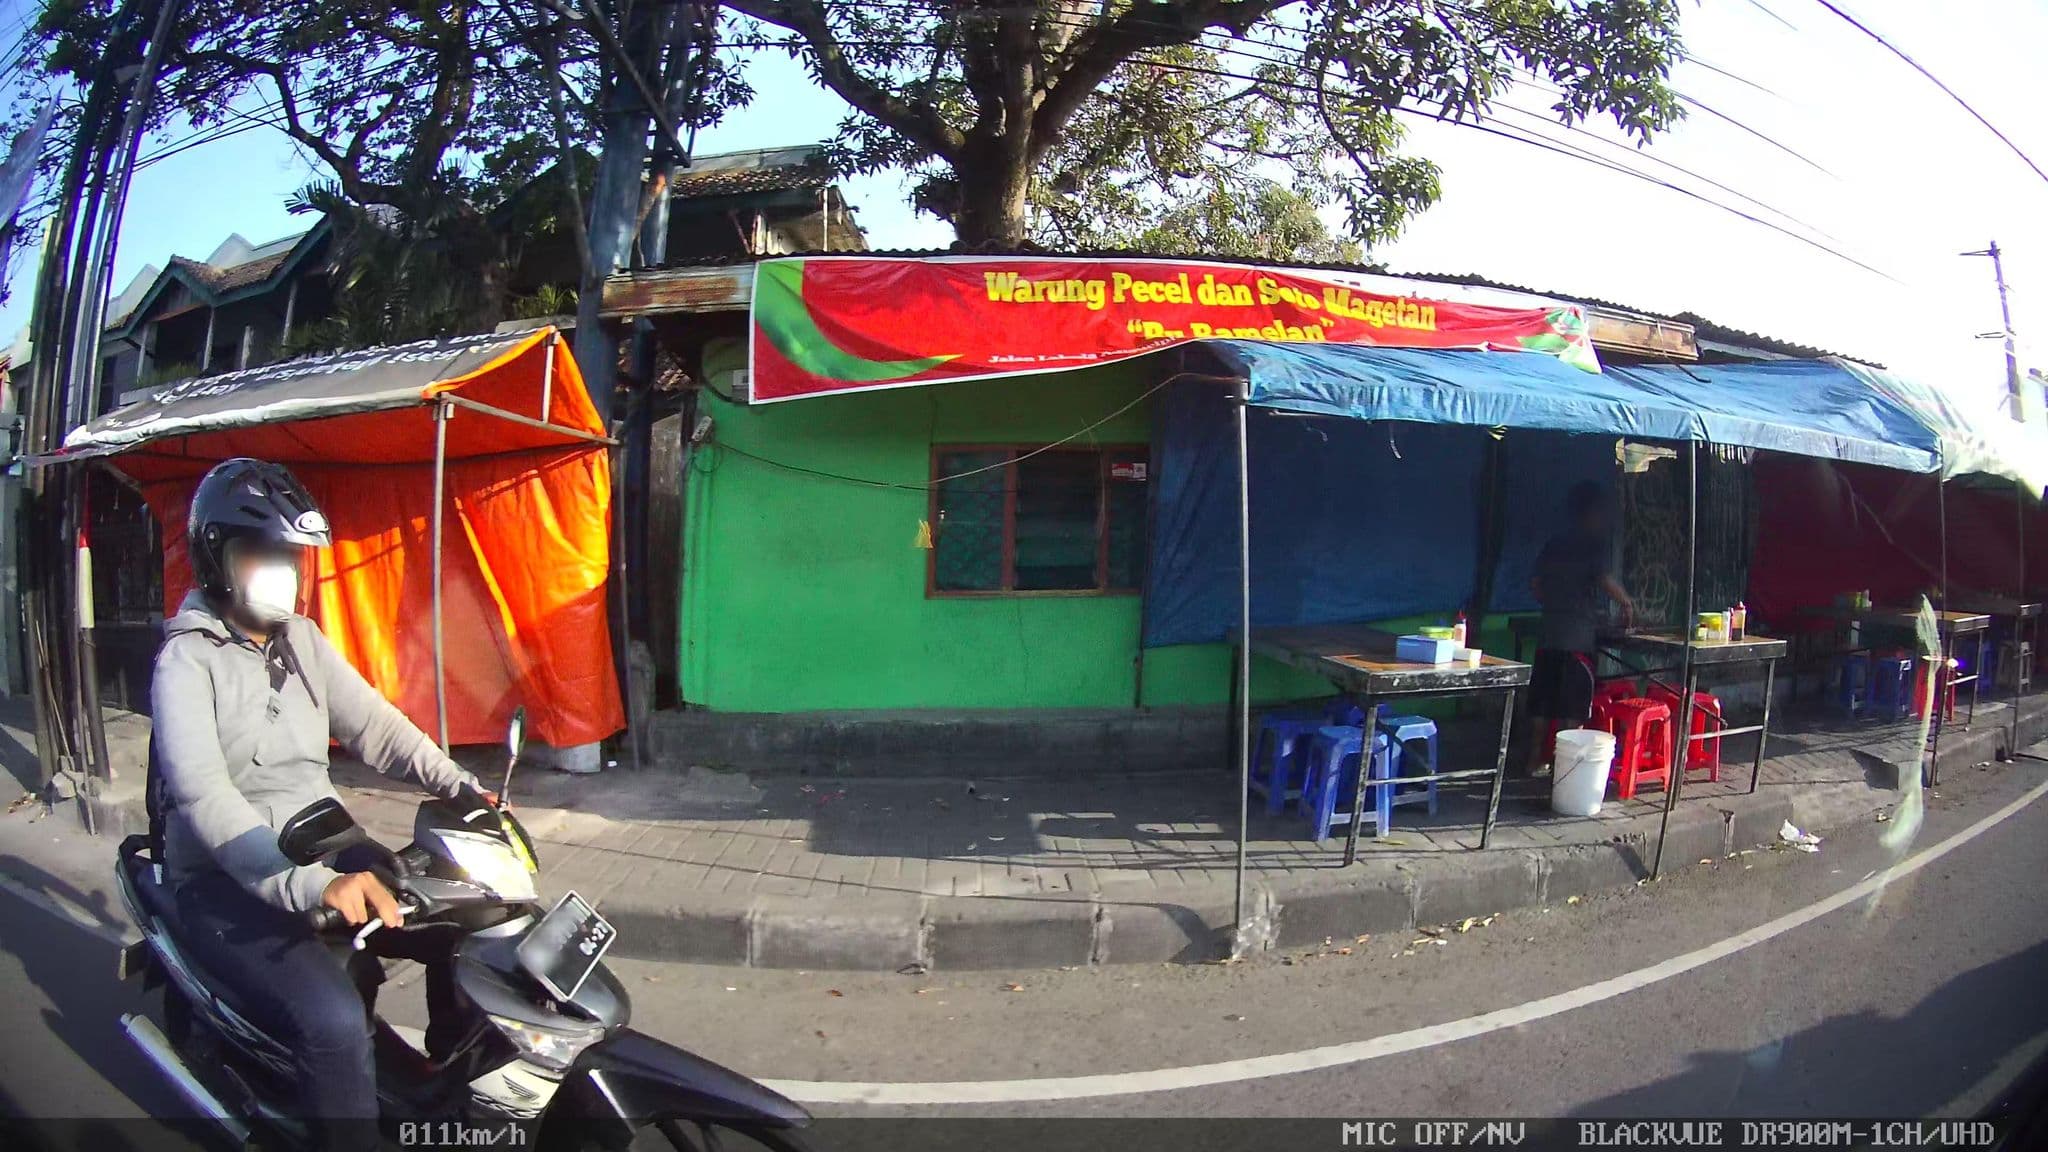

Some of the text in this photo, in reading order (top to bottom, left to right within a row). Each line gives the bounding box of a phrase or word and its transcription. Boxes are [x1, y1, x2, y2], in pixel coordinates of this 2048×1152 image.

[984, 271, 1106, 310] Warung
[1111, 272, 1193, 304] Pecel
[1197, 274, 1254, 306] dan
[1322, 287, 1437, 331] Magetan
